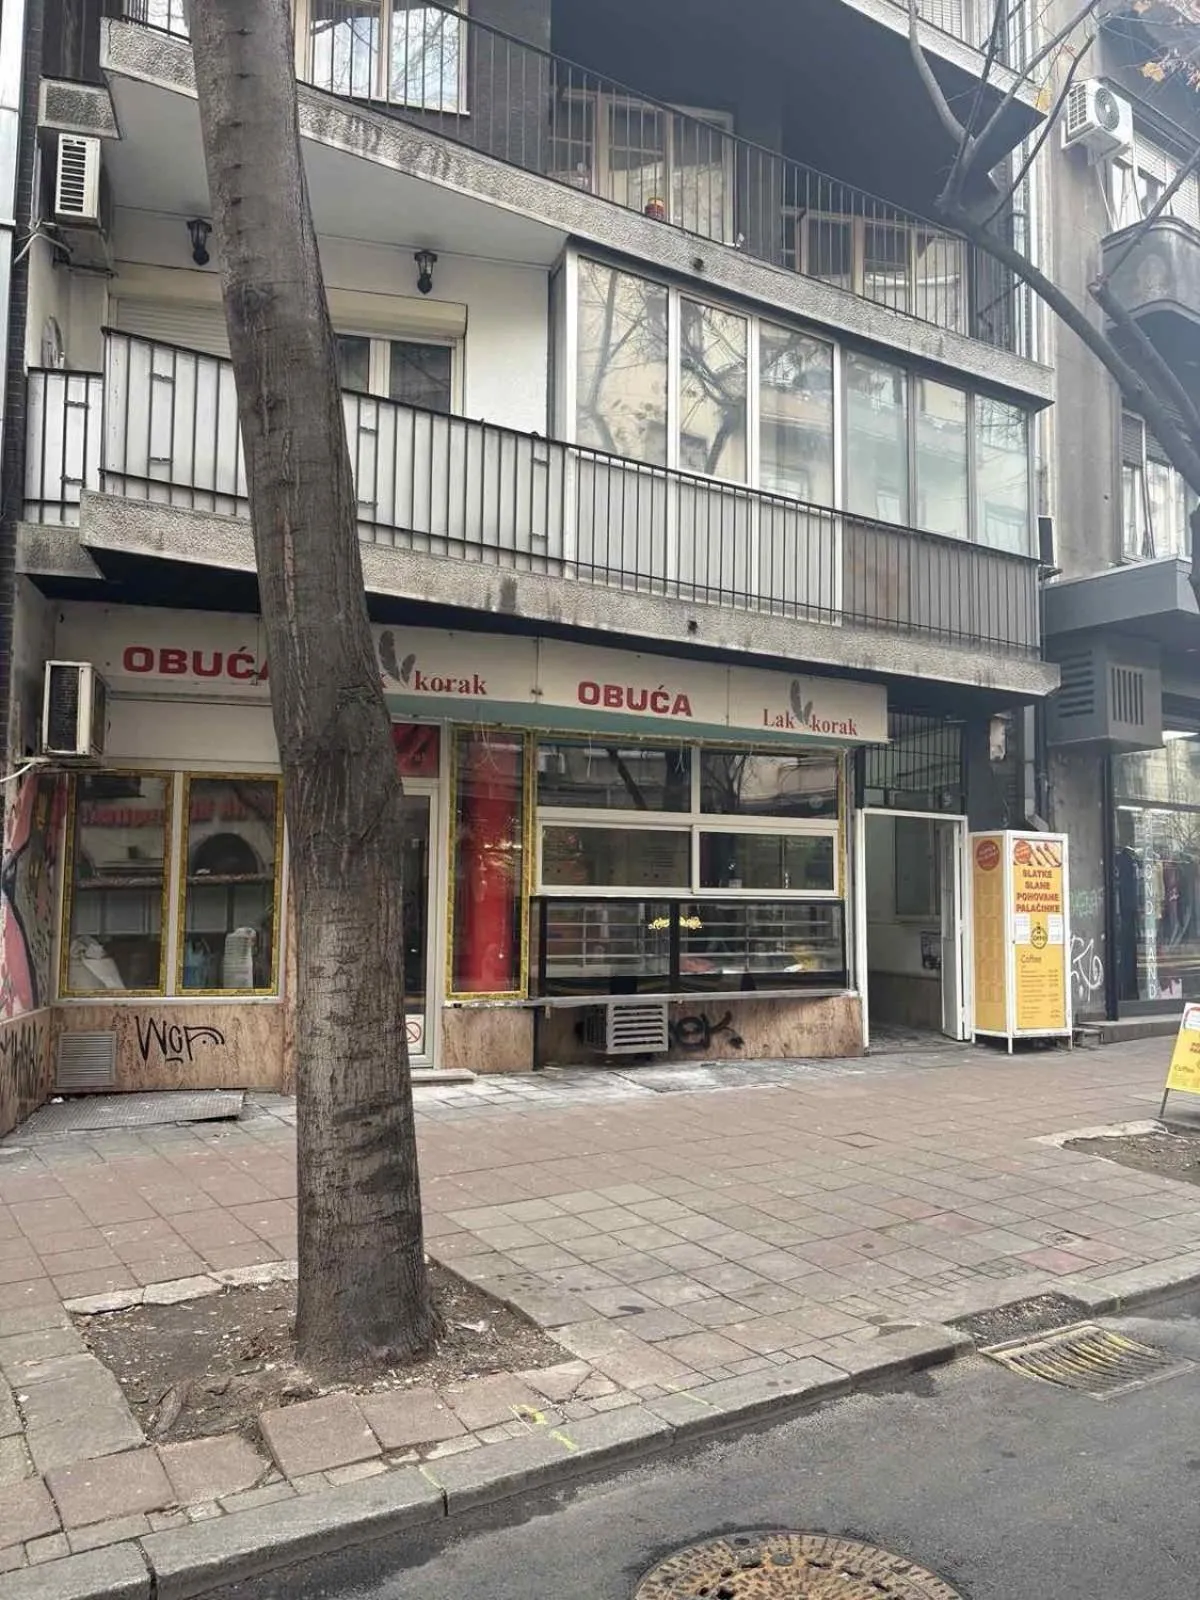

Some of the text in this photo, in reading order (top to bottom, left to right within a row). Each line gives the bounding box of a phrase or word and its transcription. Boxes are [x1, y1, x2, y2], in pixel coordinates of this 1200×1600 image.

[414, 670, 488, 696] korak
[577, 682, 693, 718] OBUĆA
[763, 709, 858, 737] Lak korak
[1022, 869, 1053, 879] SLATKE
[1024, 881, 1051, 890] SLANE
